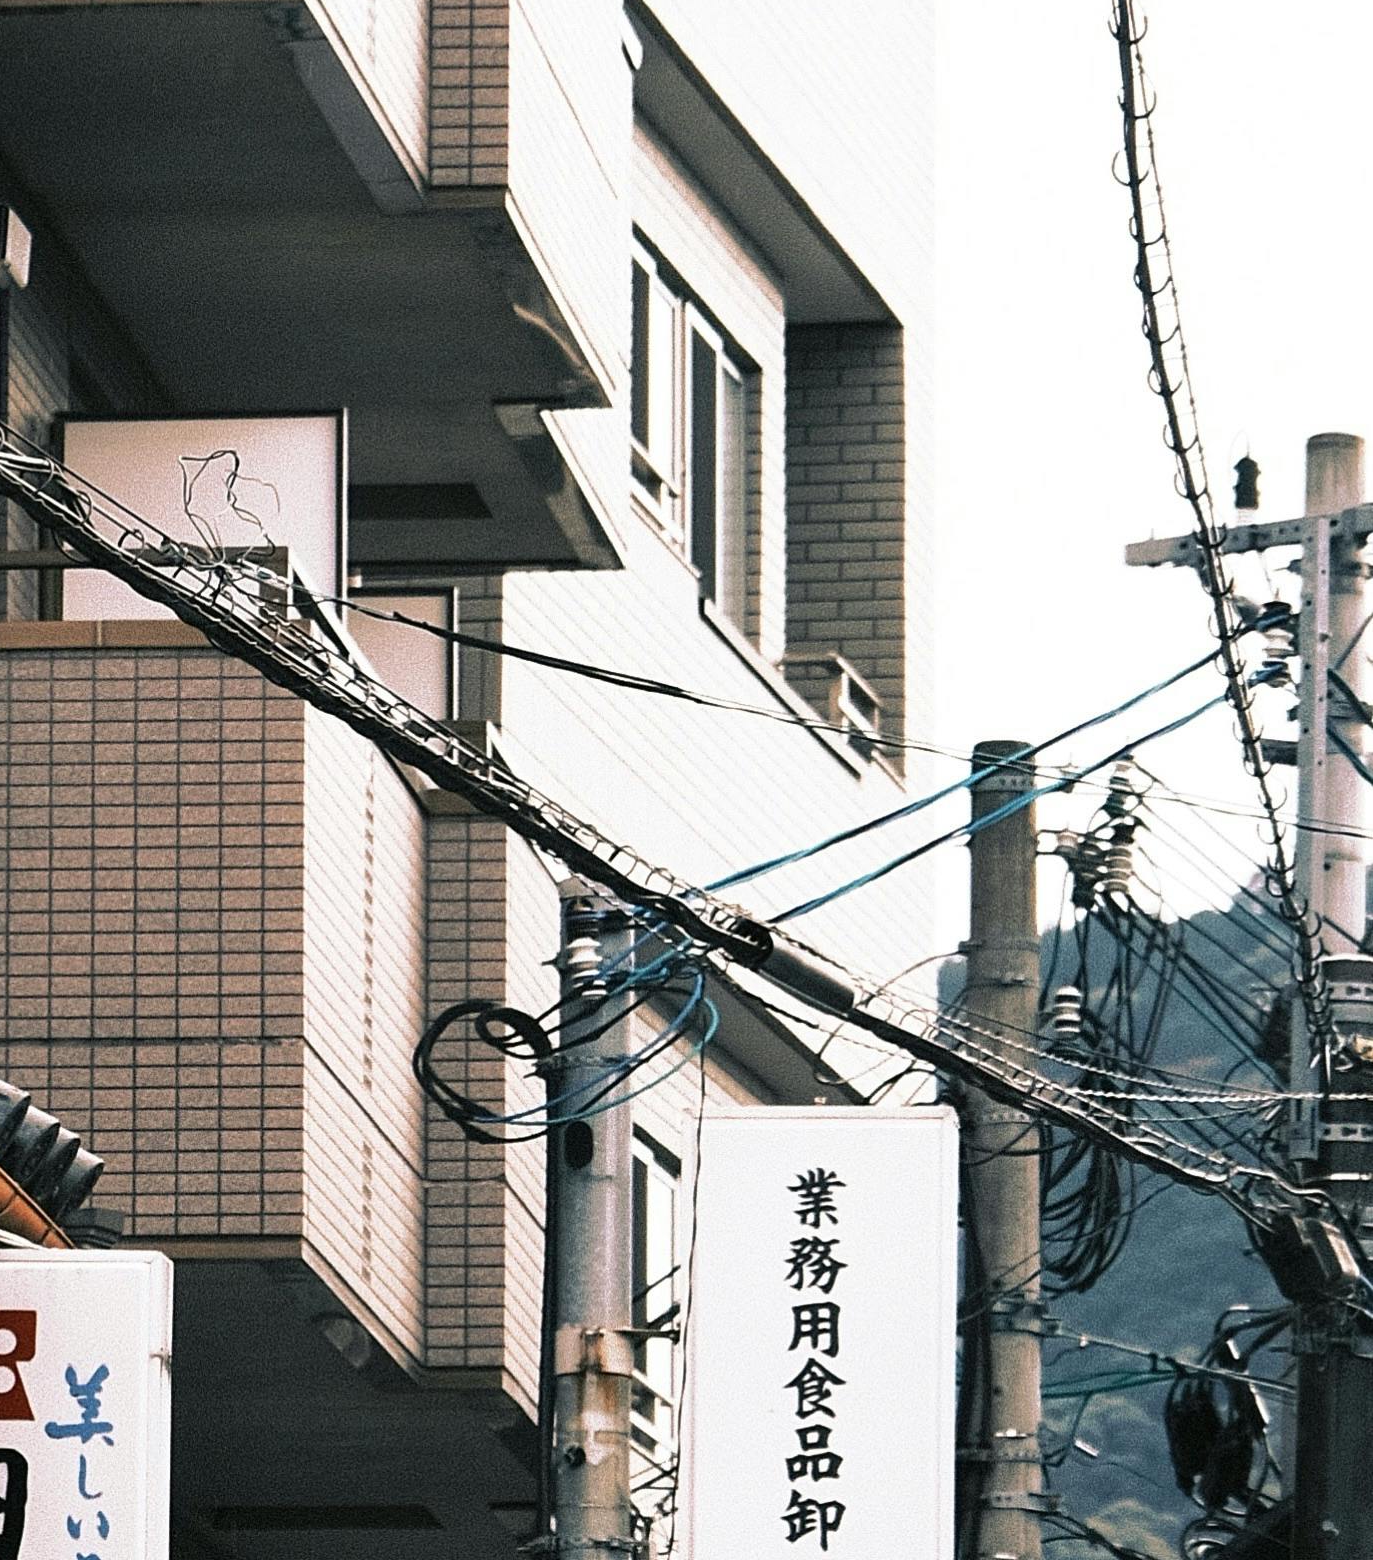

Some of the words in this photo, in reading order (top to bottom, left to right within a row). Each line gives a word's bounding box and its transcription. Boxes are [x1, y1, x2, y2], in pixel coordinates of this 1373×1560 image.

[781, 1167, 848, 1552] 業務用食品卸
